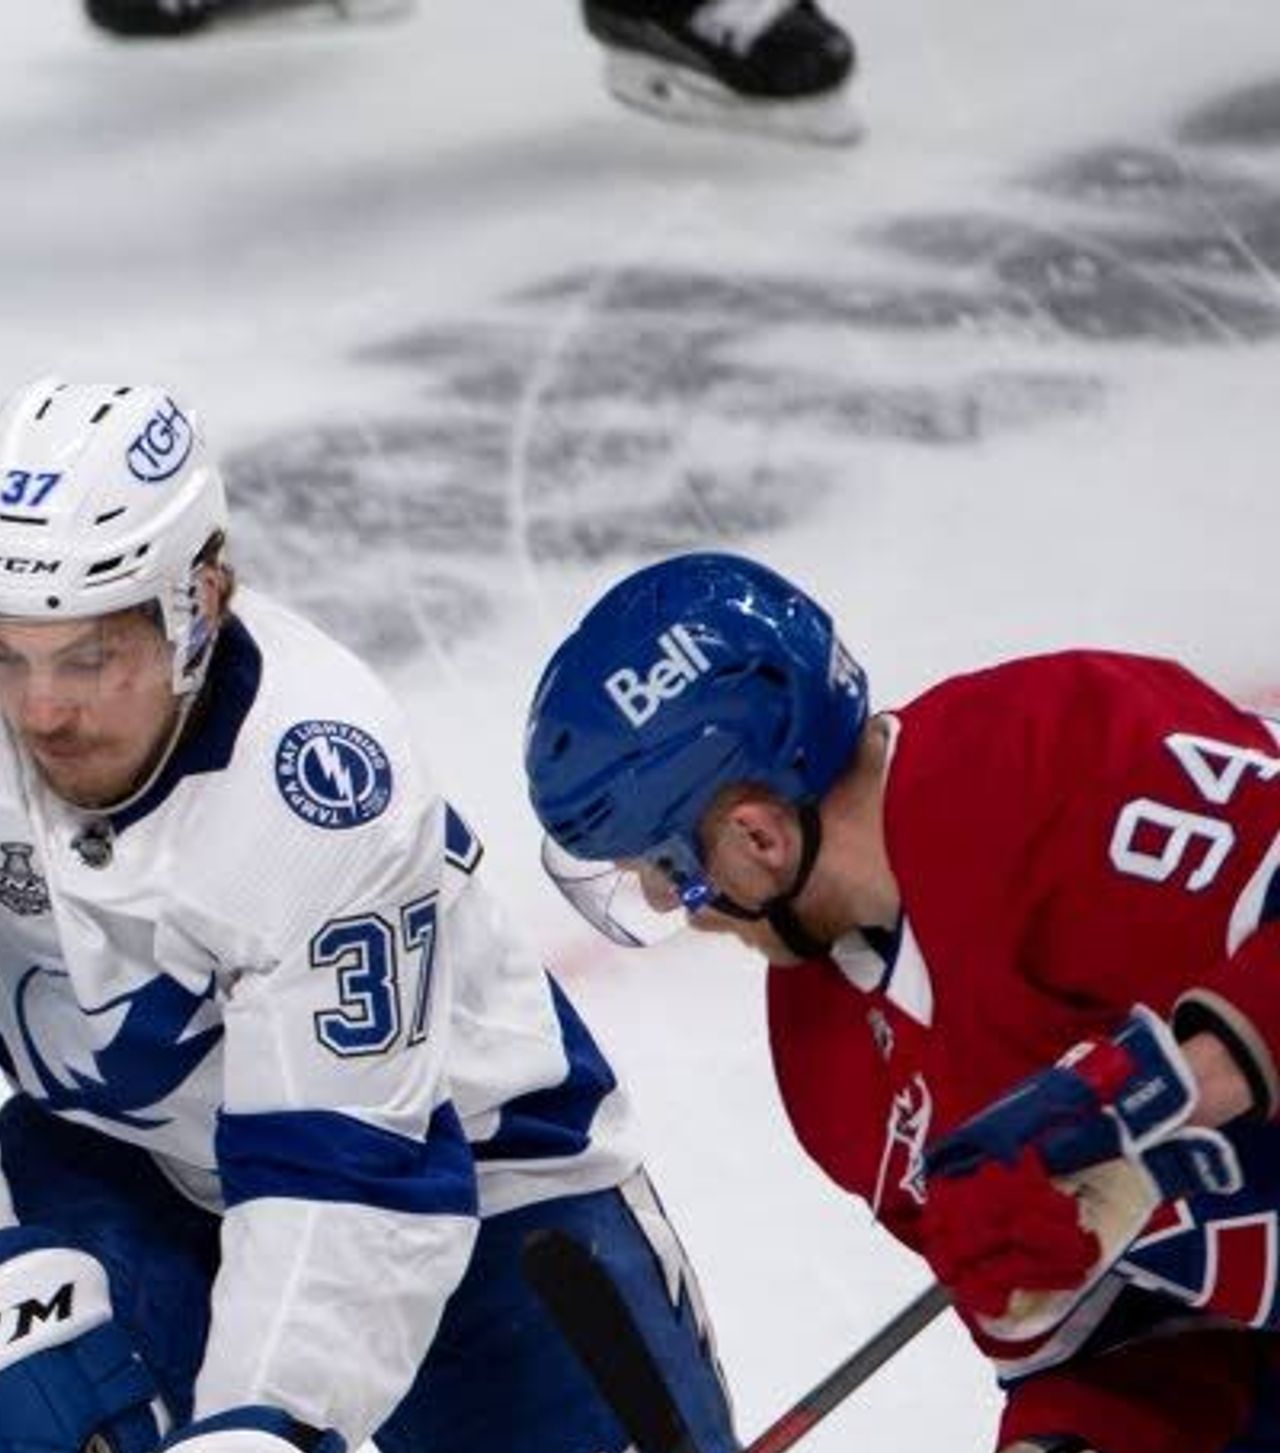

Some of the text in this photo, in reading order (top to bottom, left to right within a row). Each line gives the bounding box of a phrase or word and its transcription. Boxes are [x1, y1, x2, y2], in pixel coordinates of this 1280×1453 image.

[0, 469, 62, 507] 37
[604, 623, 712, 729] Bell
[1108, 732, 1280, 891] 94
[309, 888, 440, 1059] 37
